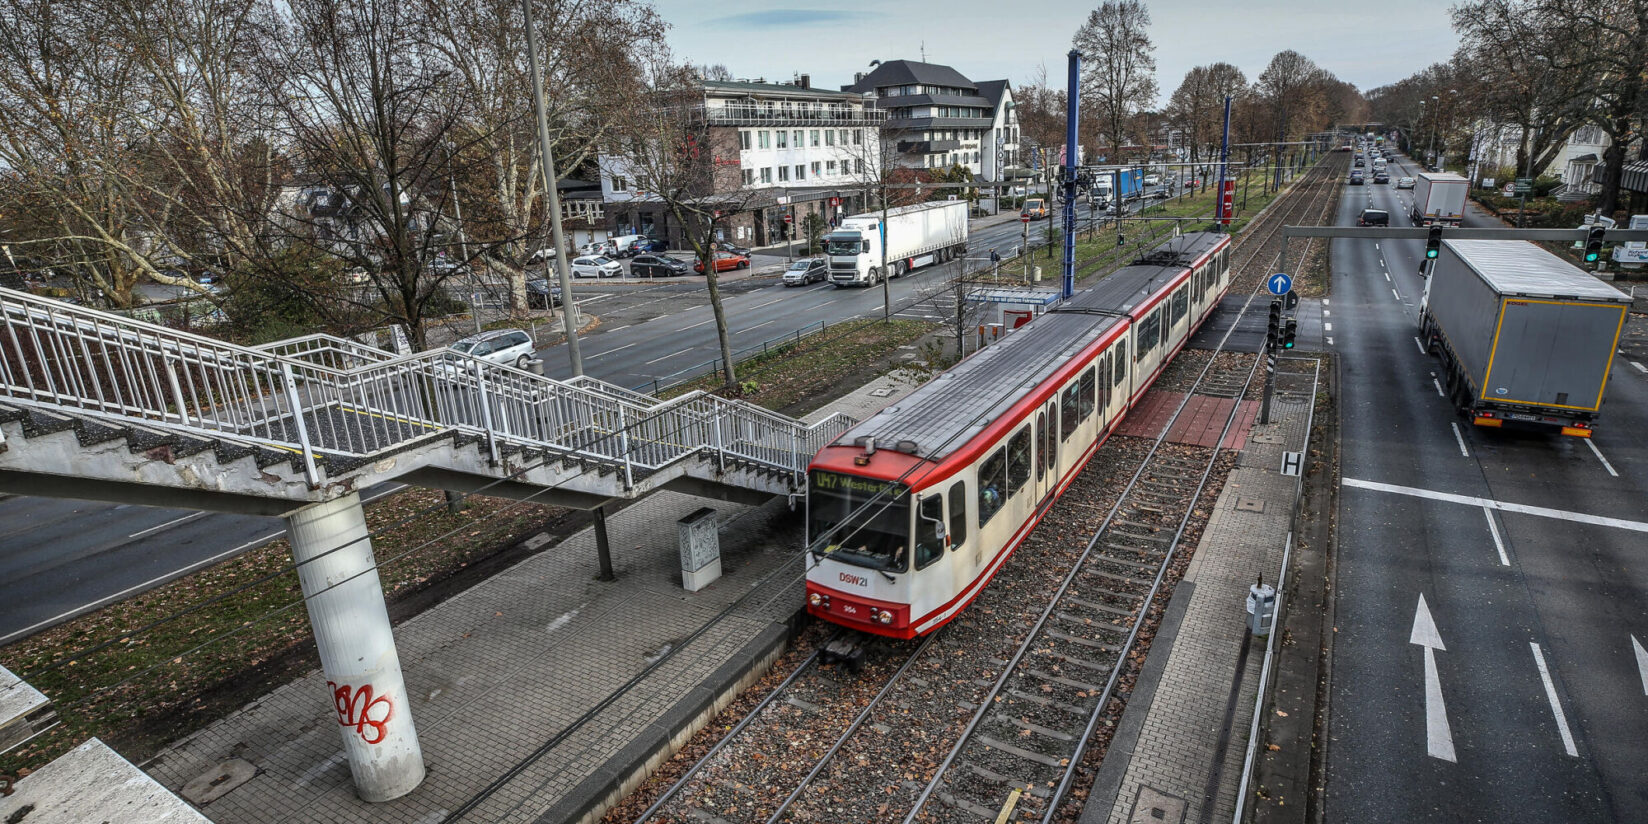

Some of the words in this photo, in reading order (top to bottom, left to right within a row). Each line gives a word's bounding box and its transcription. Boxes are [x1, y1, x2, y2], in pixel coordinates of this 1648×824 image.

[1283, 452, 1302, 476] H
[816, 472, 837, 489] U47
[839, 572, 868, 587] DSW21
